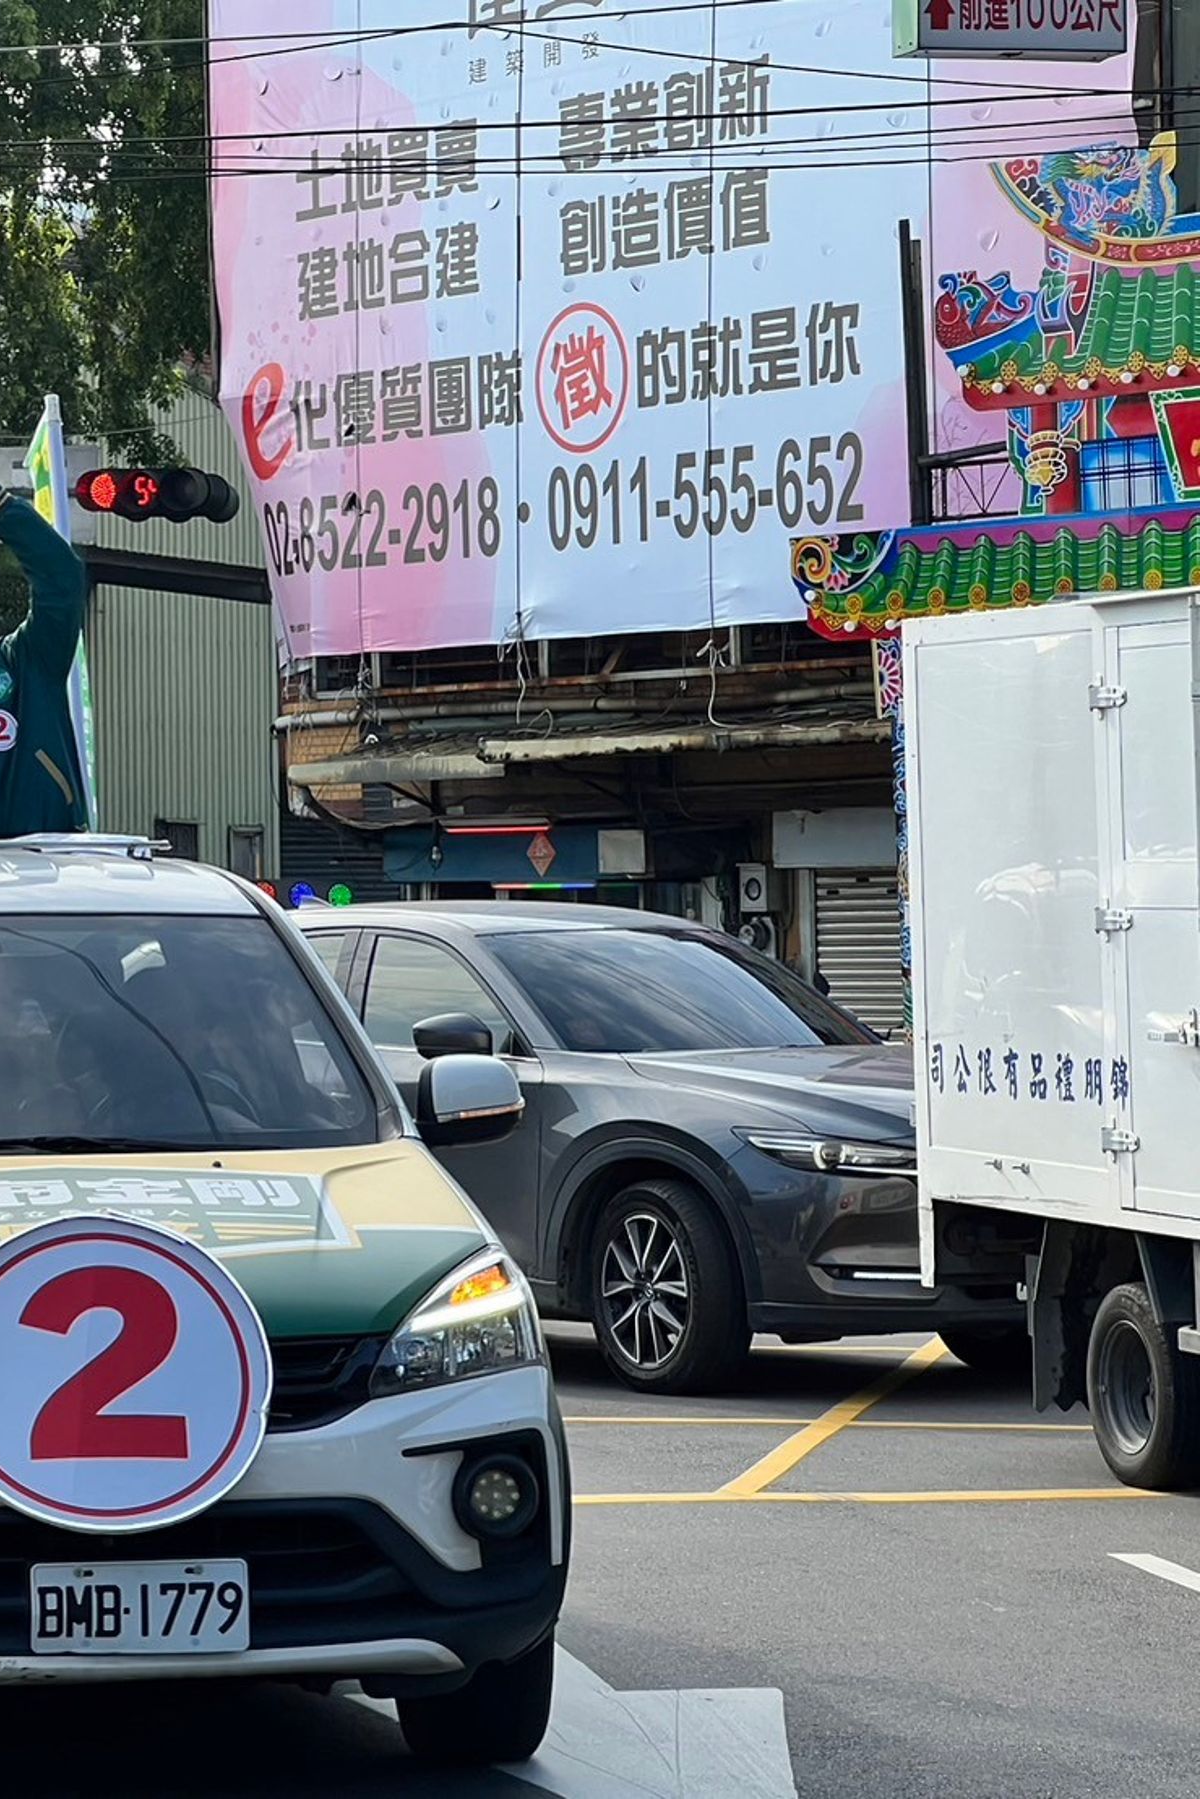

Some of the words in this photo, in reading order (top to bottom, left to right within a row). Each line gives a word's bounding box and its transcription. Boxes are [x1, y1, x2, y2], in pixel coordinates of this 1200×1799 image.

[467, 30, 600, 85] 建築開發
[557, 53, 770, 172] 專業創新
[295, 117, 479, 222] 土地買賣
[559, 168, 771, 276] 創造價值
[297, 220, 480, 322] 建地合建
[18, 1264, 189, 1460] 2
